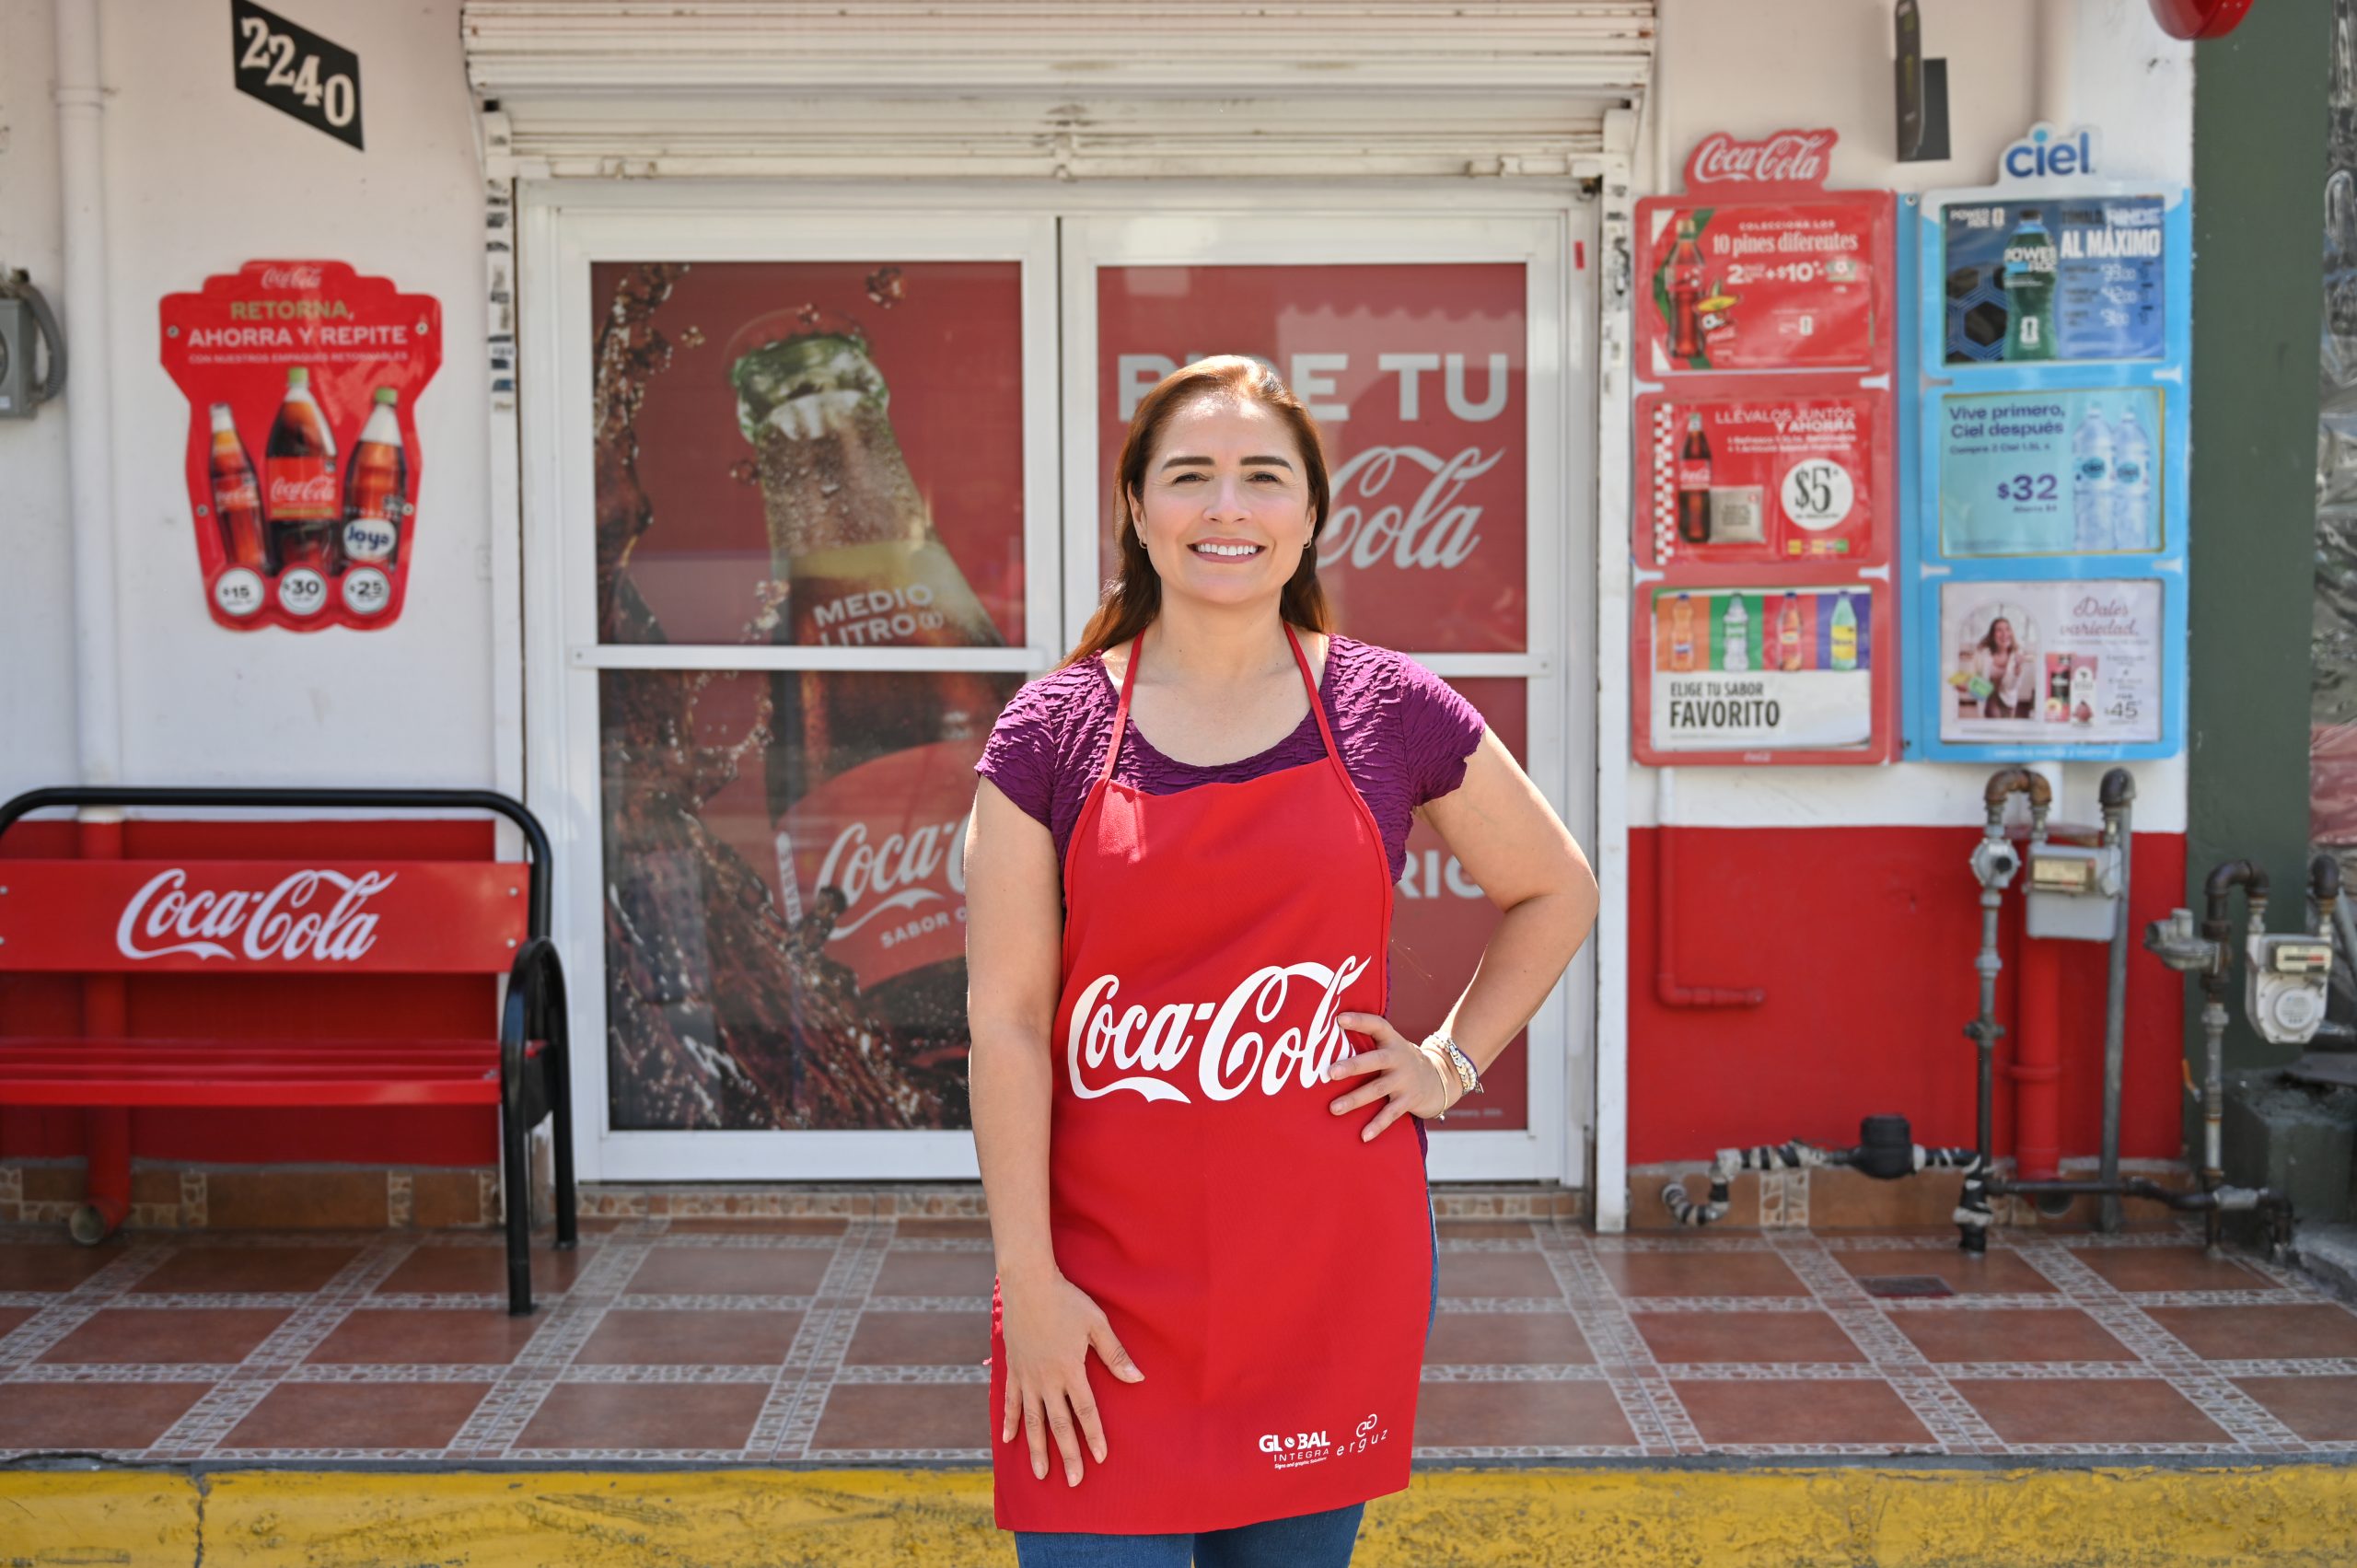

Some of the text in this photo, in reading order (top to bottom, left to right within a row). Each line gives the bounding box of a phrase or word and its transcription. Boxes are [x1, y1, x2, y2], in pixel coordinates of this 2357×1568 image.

[240, 16, 355, 127] 2240
[1694, 135, 1828, 183] Coca-Cola
[2005, 129, 2090, 177] ciel
[1713, 230, 1859, 258] 10 pines diferentes
[2061, 223, 2161, 258] AL MÁXIMO
[231, 300, 354, 321] RETORNA,
[188, 325, 407, 348] AHORRA Y REPITE
[214, 354, 269, 364] NUESTROS
[1118, 354, 1508, 422] PE TU
[1949, 403, 2065, 421] Vive primero,
[1951, 421, 2063, 439] Ciel después
[1997, 475, 2058, 501] $32
[814, 582, 934, 627] MEDIO
[1670, 681, 1764, 696] ELIGE TU SABOR
[1669, 700, 1781, 727] FAVORITO
[116, 868, 398, 960] Coca-Cola
[880, 912, 950, 949] SABOR
[1273, 1447, 1329, 1462] INTEGRA
[1336, 1429, 1388, 1457] erguz
